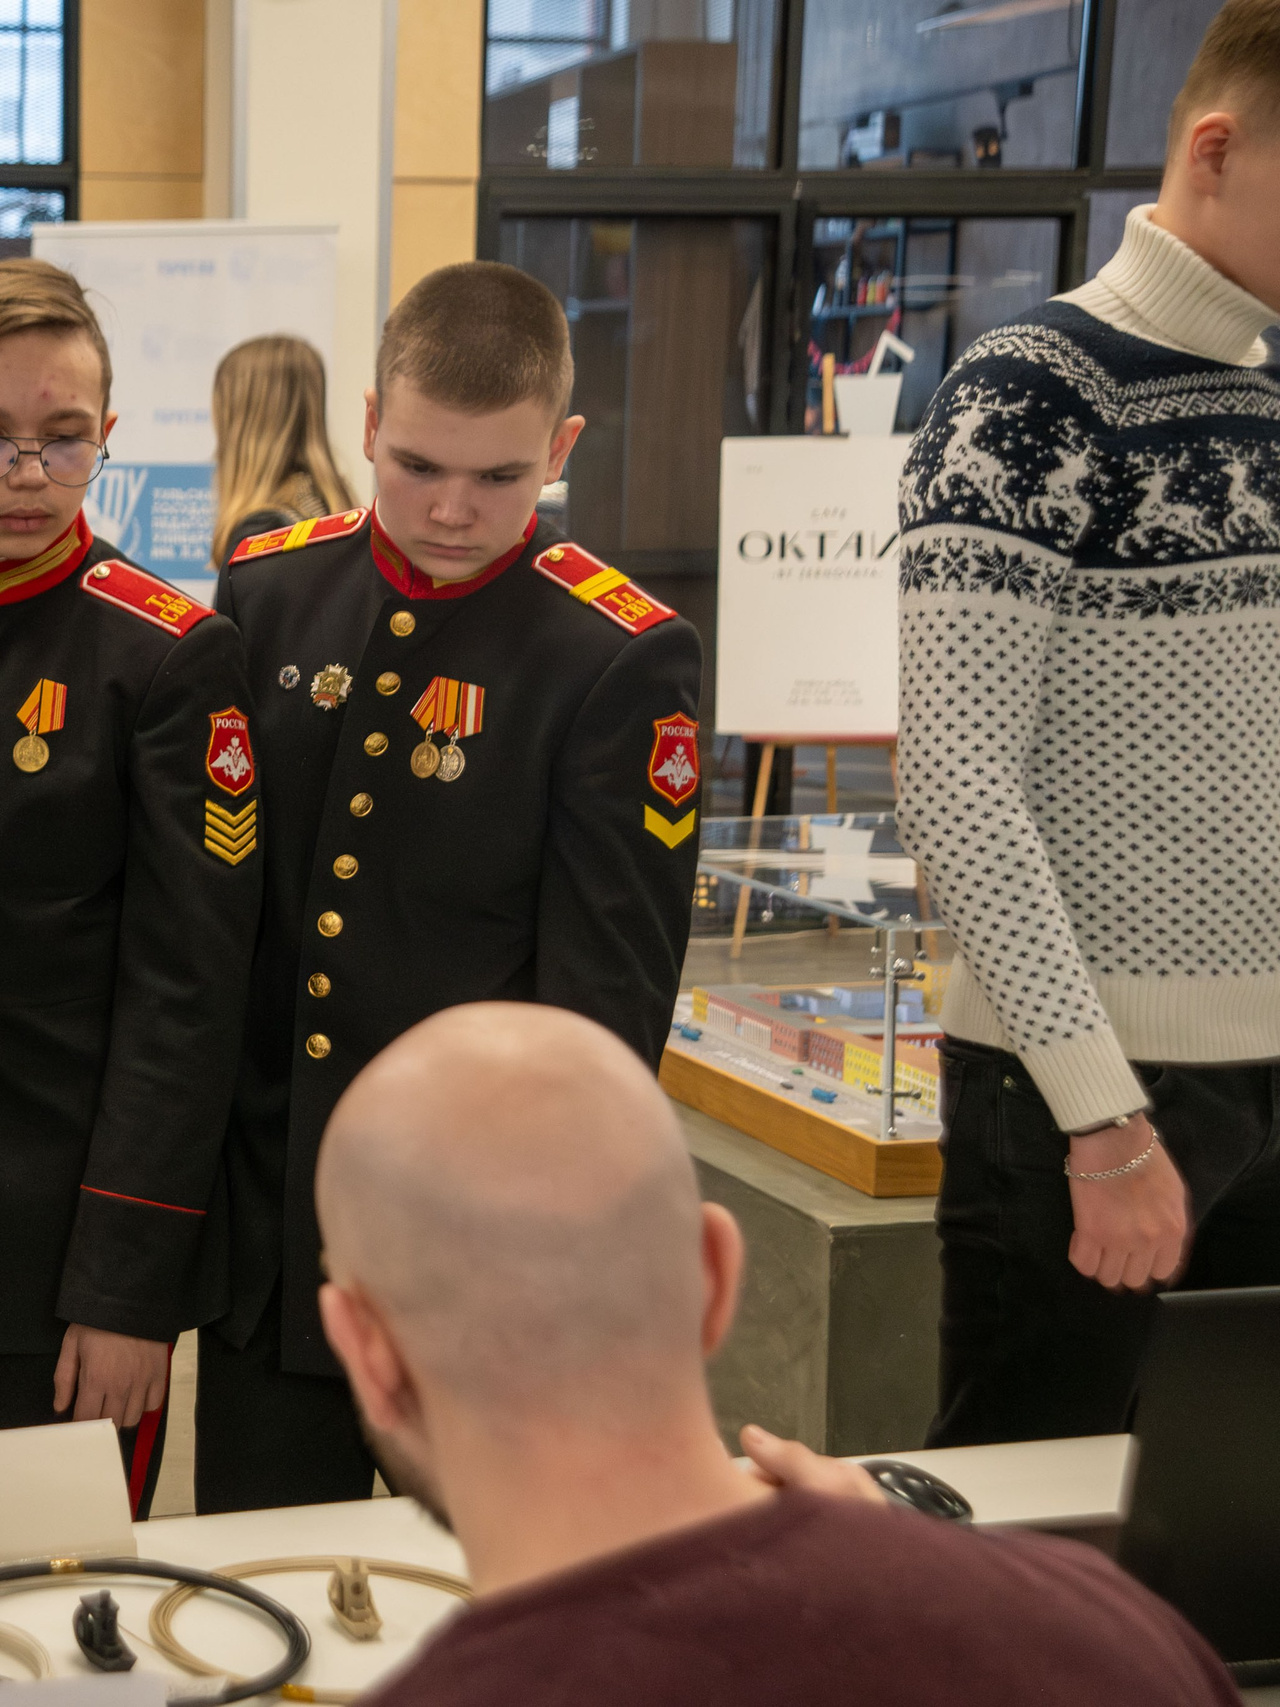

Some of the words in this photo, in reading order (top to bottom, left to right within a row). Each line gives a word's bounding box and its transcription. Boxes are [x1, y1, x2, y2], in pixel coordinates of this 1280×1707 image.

[159, 596, 193, 623] СВУ
[617, 597, 654, 623] СВУ
[660, 725, 695, 738] РОССИЯ
